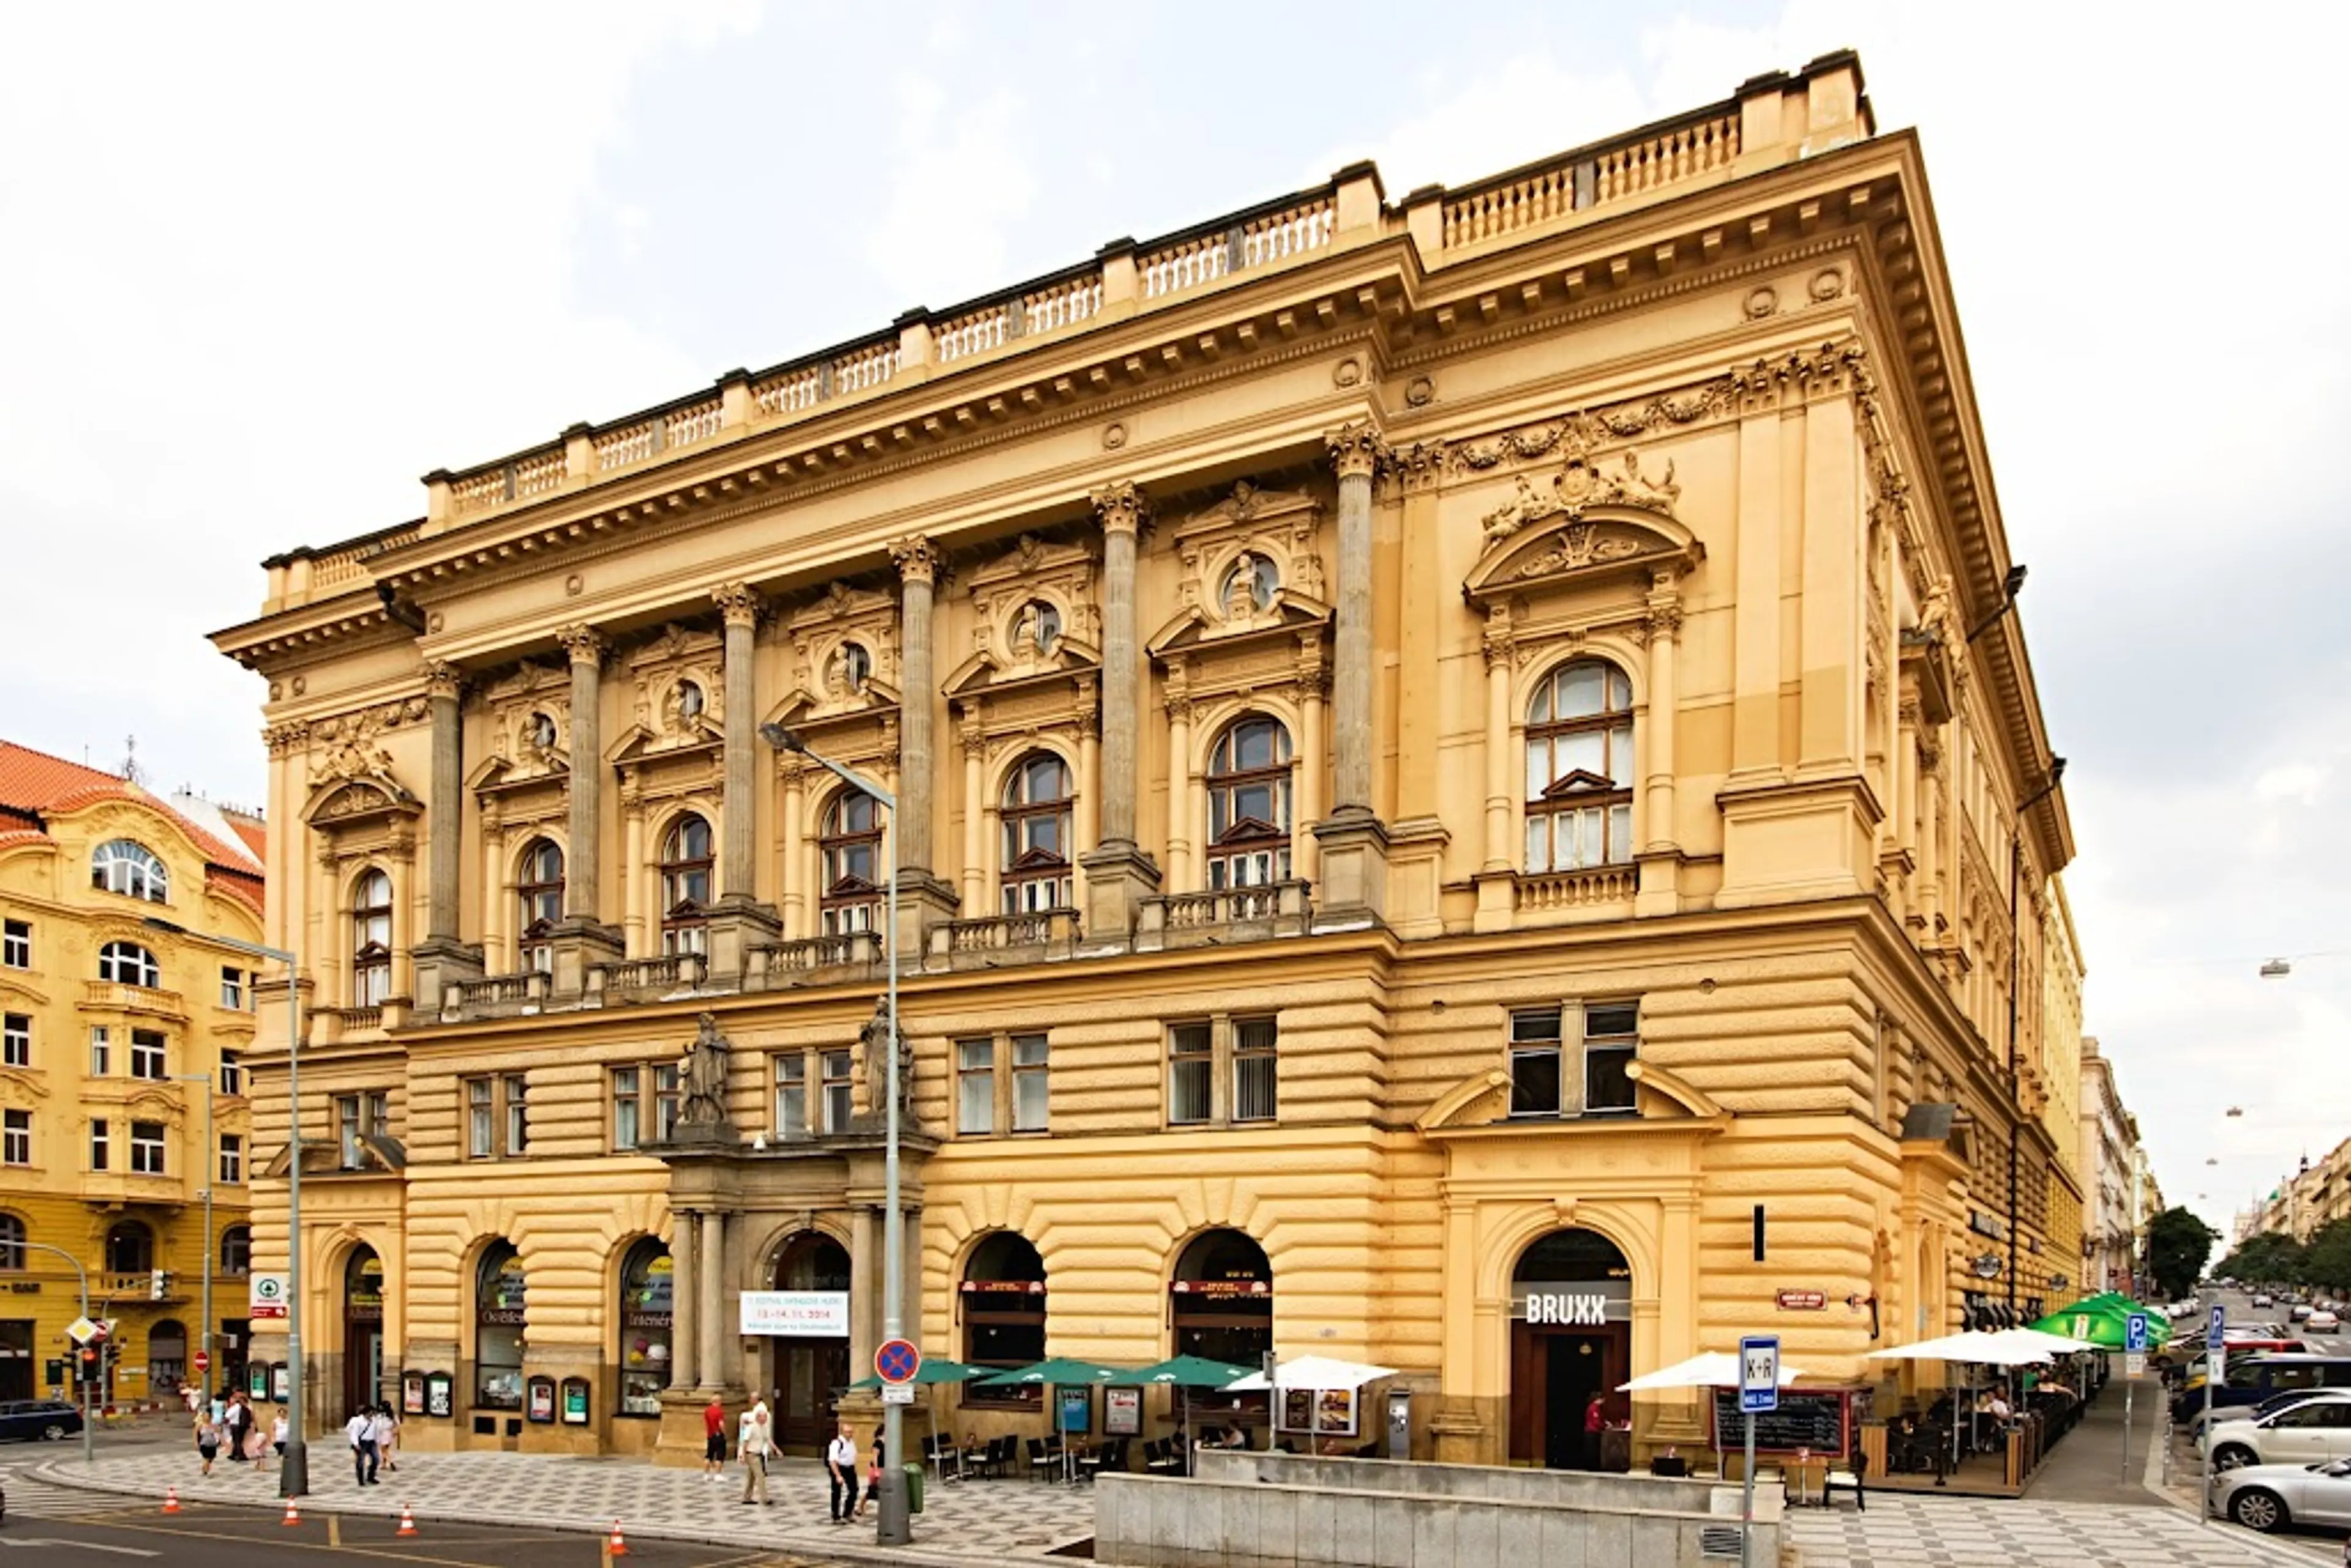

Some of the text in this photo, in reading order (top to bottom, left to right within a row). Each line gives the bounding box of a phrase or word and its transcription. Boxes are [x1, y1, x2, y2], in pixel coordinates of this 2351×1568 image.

[1526, 1294, 1606, 1325] BRUXX
[2131, 1318, 2143, 1340] P
[1747, 1357, 1772, 1379] K+R
